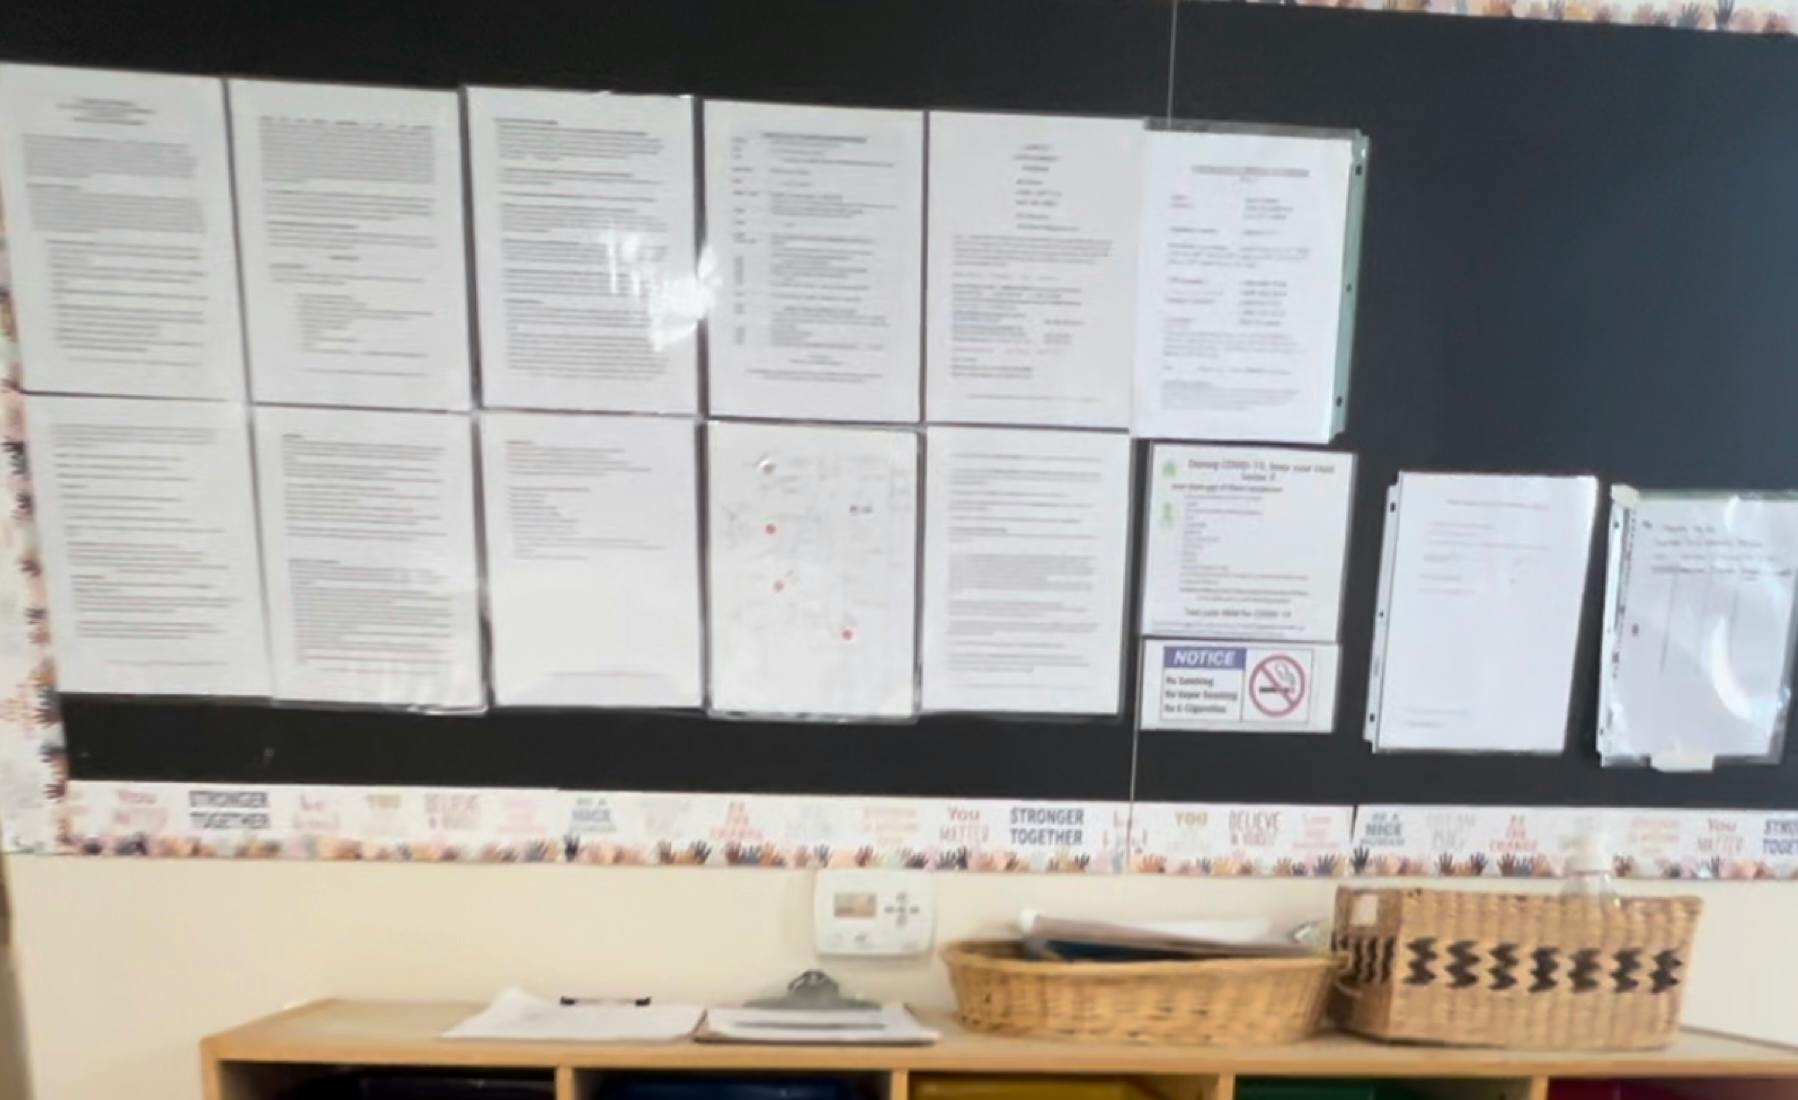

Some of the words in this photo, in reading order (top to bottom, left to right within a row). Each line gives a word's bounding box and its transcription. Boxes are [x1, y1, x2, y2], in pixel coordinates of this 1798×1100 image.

[1173, 650, 1236, 667] NOTICE
[1010, 807, 1084, 825] STRONGER
[1010, 827, 1083, 846] TOGETHER
[1365, 823, 1402, 836] NICE
